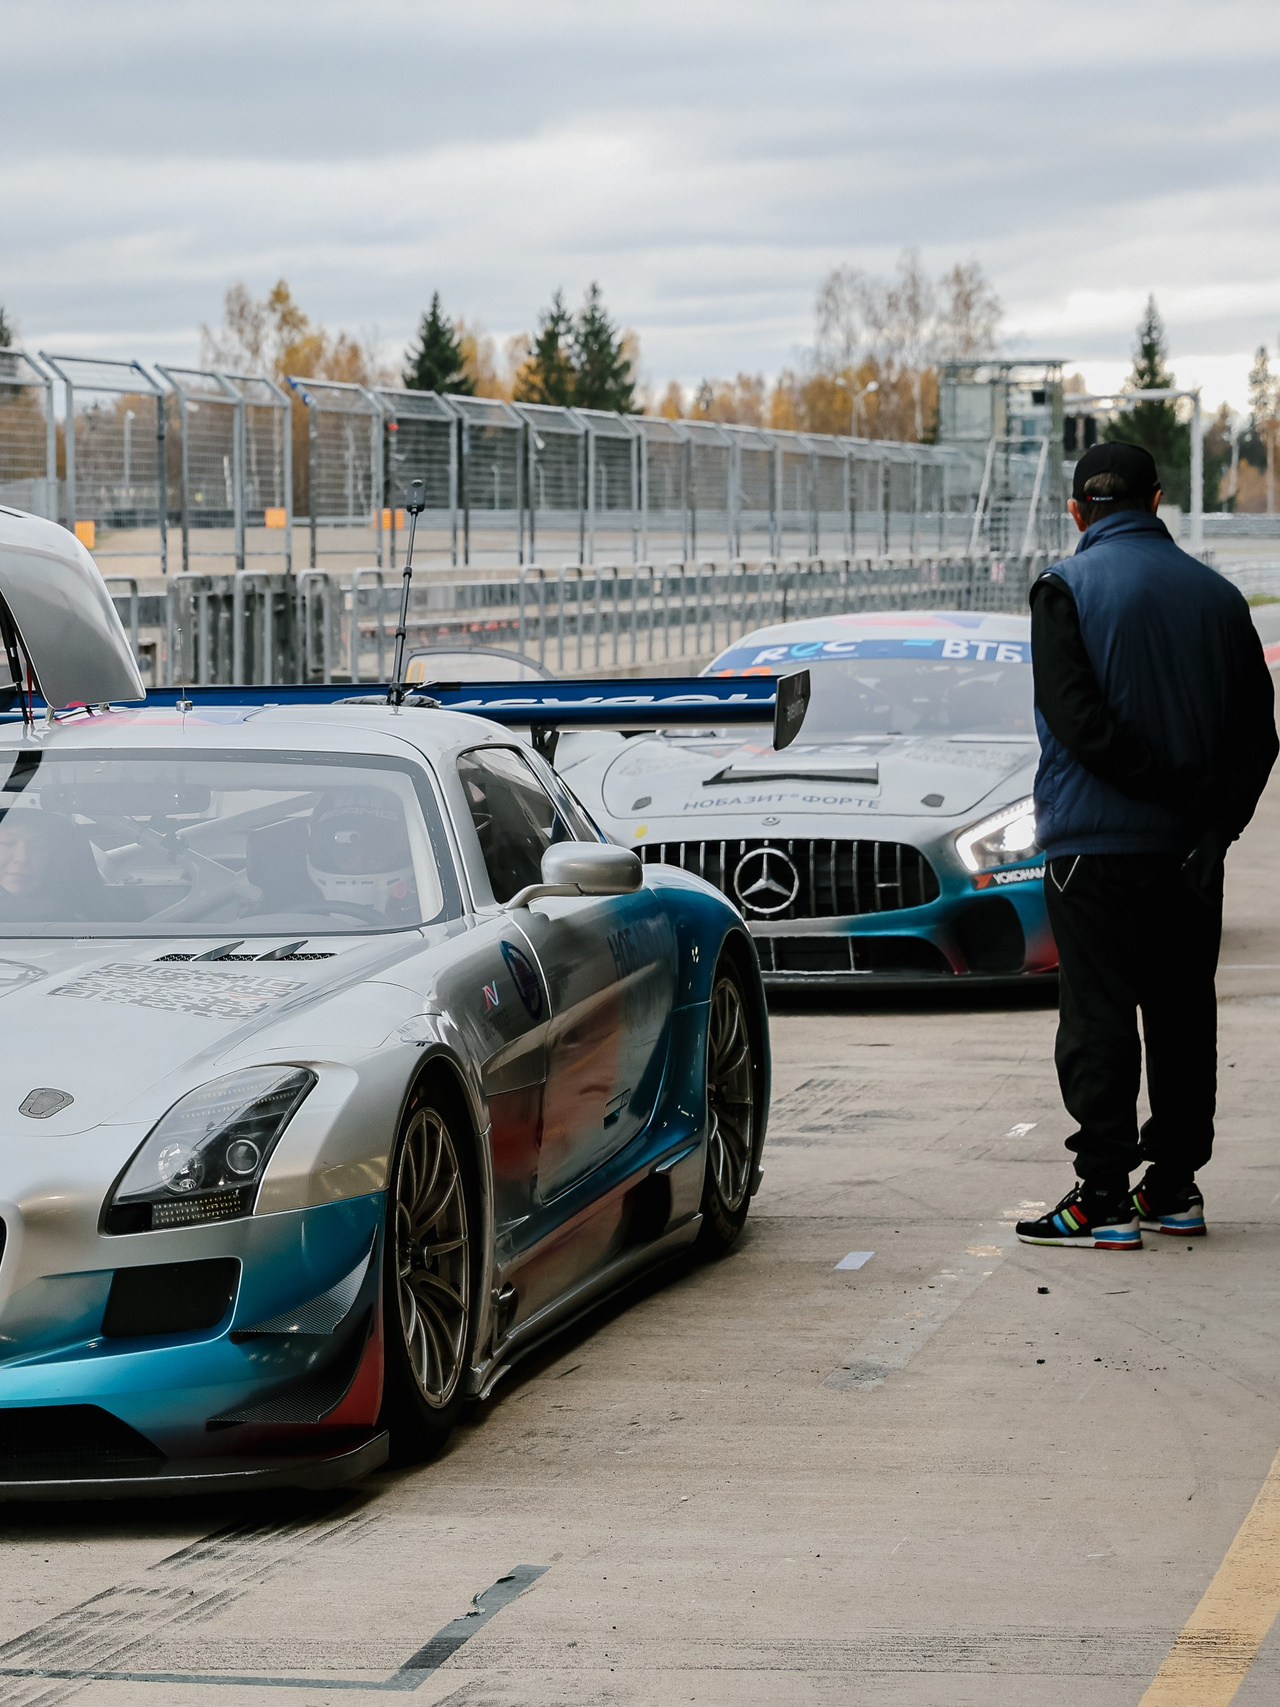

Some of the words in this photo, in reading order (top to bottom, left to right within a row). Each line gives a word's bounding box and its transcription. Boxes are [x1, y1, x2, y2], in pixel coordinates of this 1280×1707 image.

[941, 639, 1024, 664] ВТБ
[802, 796, 881, 810] ФОРТЕ
[993, 866, 1047, 885] YOKOHAM
